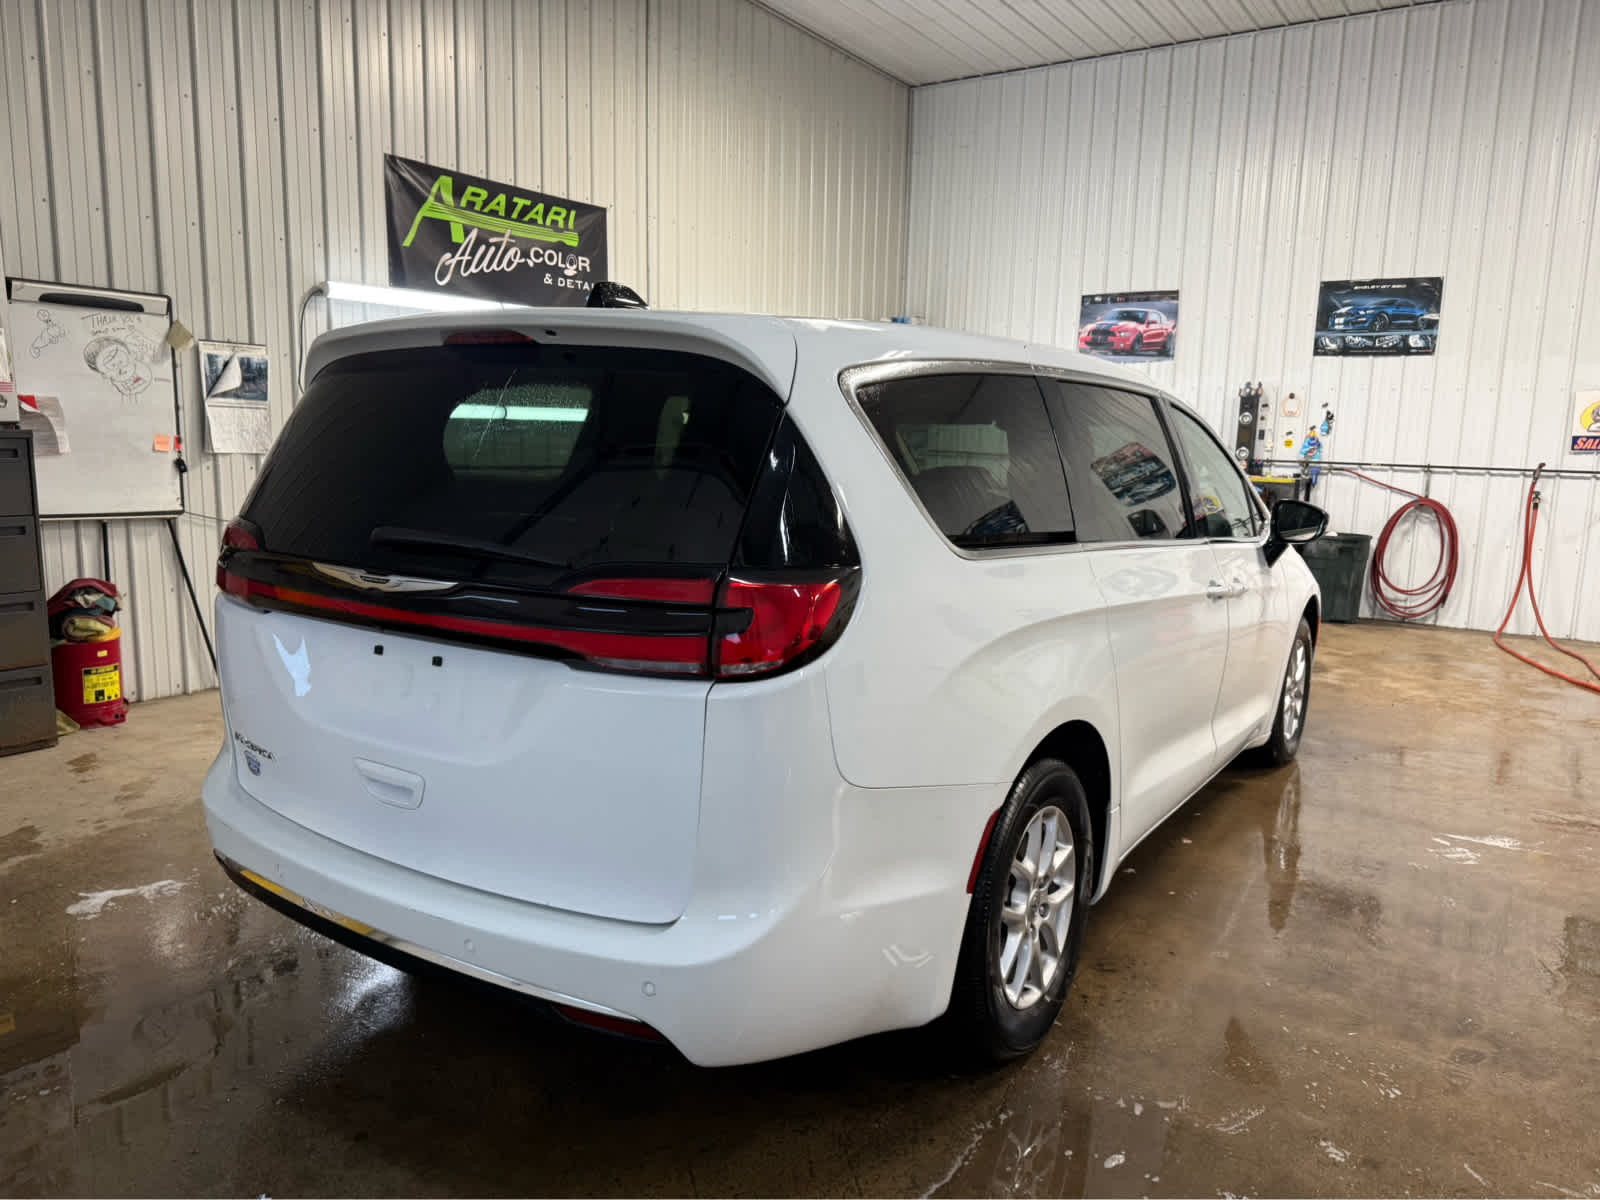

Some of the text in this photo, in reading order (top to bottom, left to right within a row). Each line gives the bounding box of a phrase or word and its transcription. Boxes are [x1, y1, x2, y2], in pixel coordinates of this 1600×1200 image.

[402, 175, 577, 247] ARATARI
[435, 228, 591, 286] Auto COLOR
[544, 273, 595, 291] & DETAI
